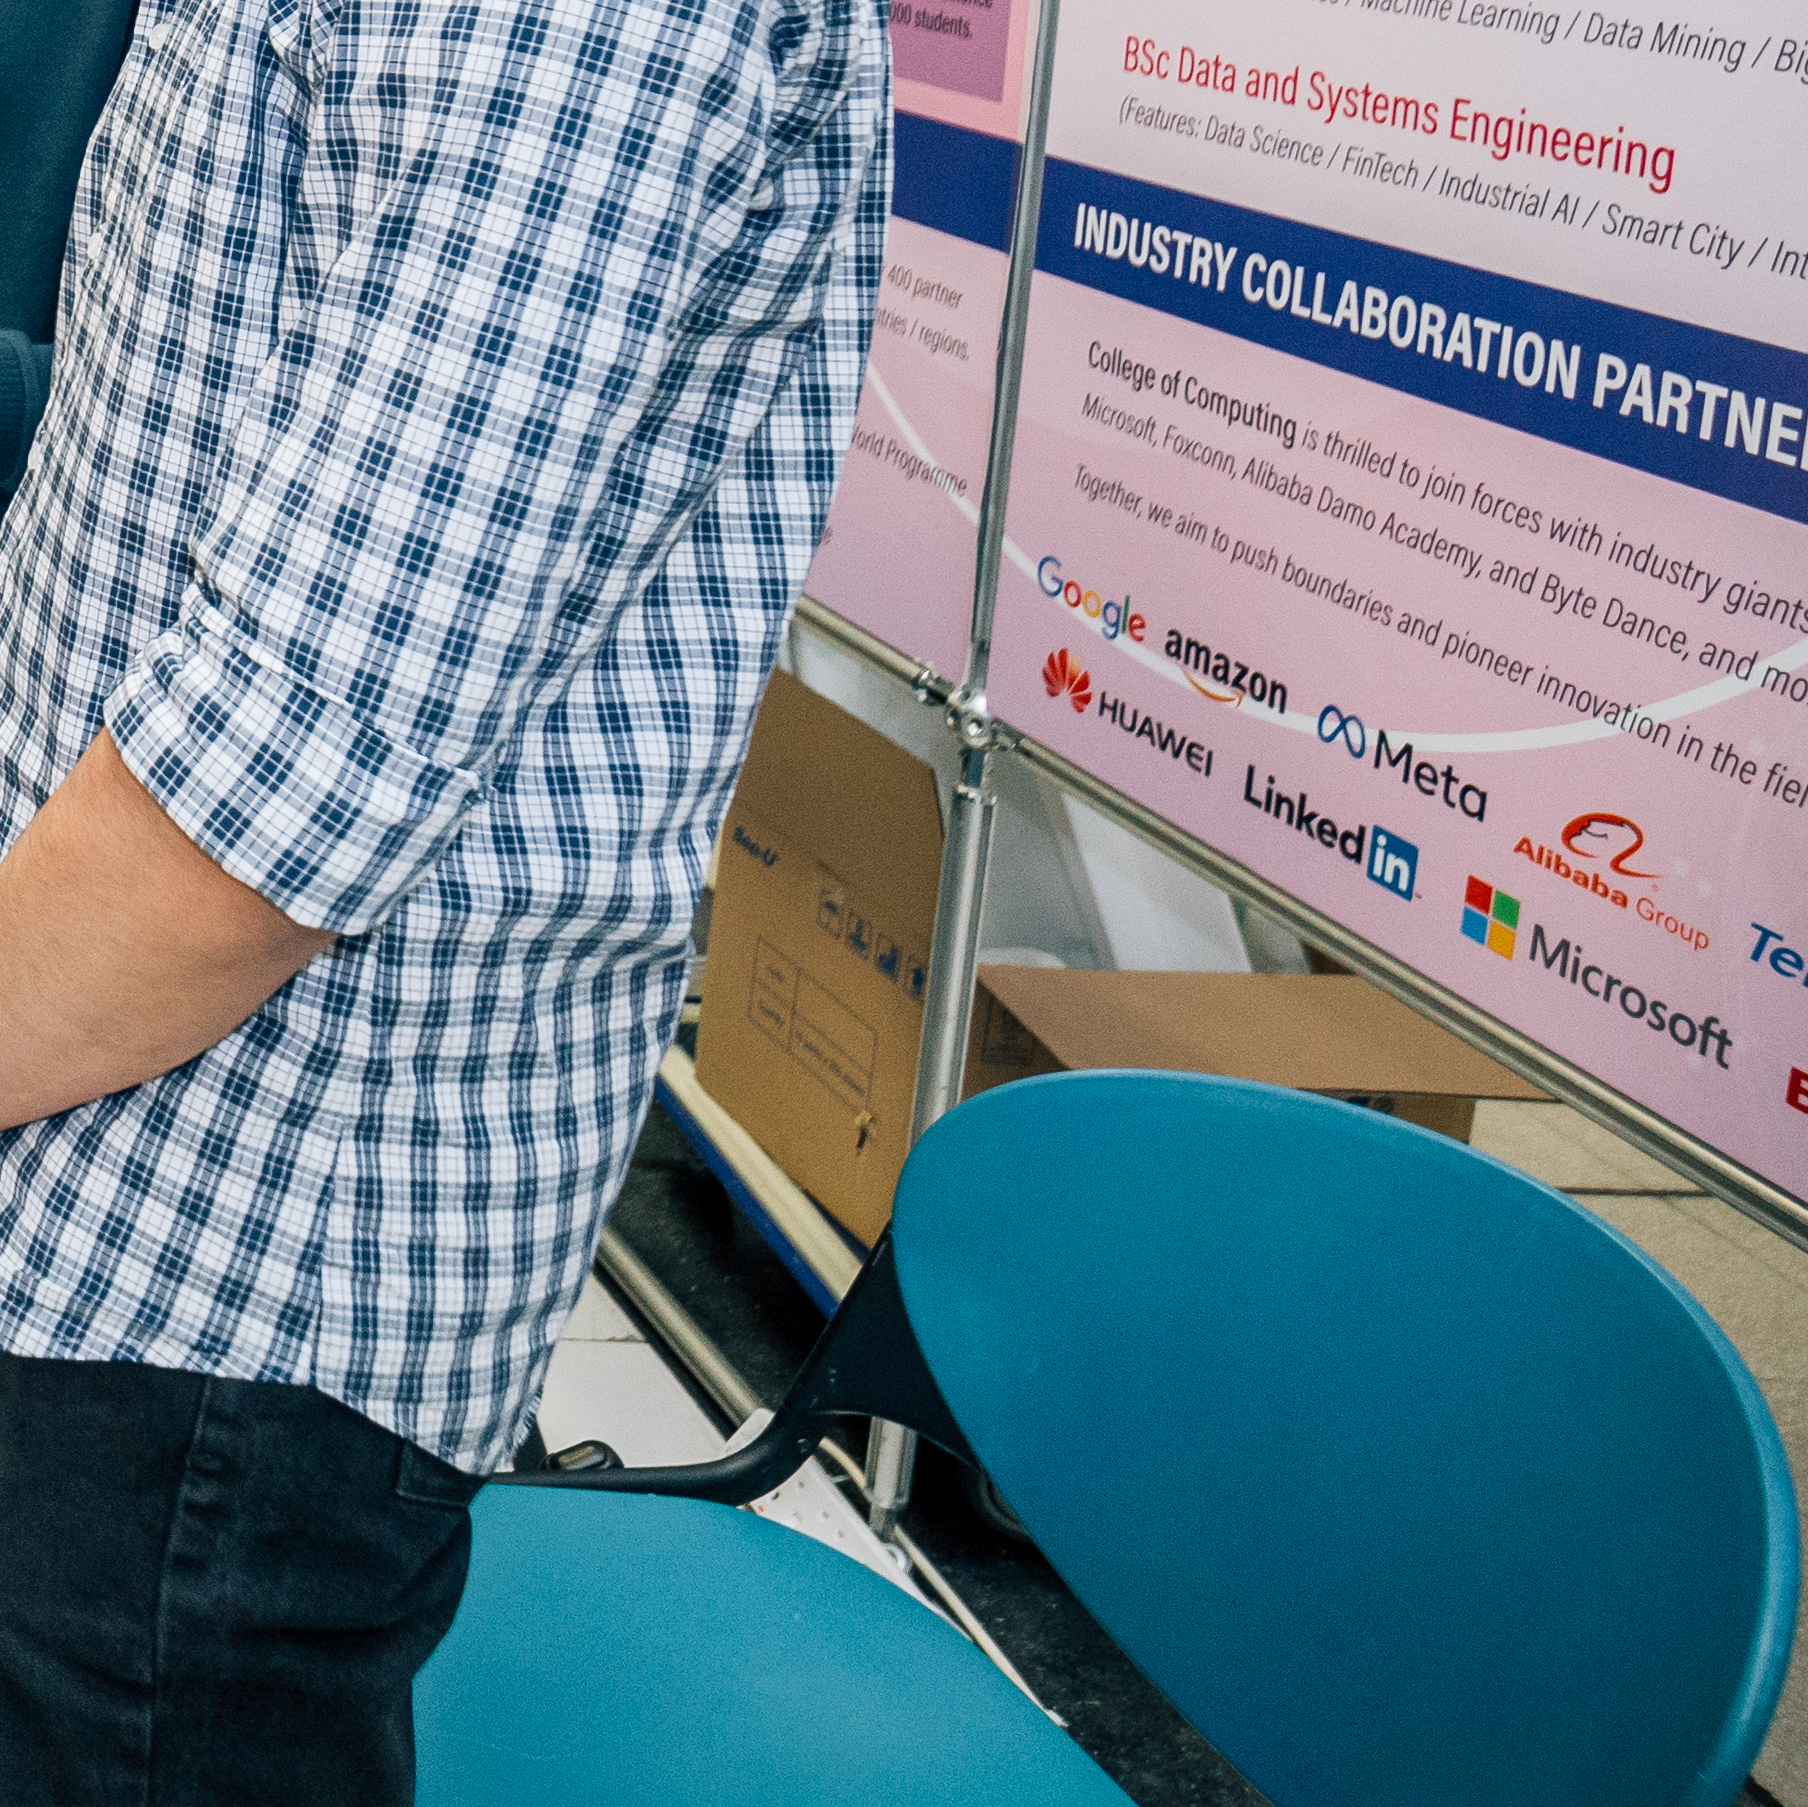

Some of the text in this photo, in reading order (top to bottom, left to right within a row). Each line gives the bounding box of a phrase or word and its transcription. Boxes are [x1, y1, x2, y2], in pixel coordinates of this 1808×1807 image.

[913, 8, 974, 40] students.
[1583, 11, 1643, 50] Data
[1652, 22, 1746, 74] Mining
[1123, 35, 1677, 194] BSc Data and Systems Engineering
[1204, 115, 1745, 271] Data Science FinTech Industrial Smart City
[913, 276, 964, 311] partner
[919, 323, 971, 361] regions.
[1073, 202, 1238, 294] INDUSTRY
[1242, 253, 1581, 401] COLLABORATION
[885, 444, 968, 498] Programme
[1080, 394, 1758, 689] Microsoft, Alibaba Damo and Byte and
[1088, 341, 1721, 604] College of Computing thrilled join forces with industry
[1036, 555, 1489, 822] Google amazon Meta
[1074, 463, 1757, 787] Together, aim push boundaries and the
[1098, 691, 1215, 779] HUAWEI
[1528, 924, 1734, 1070] Microsoft
